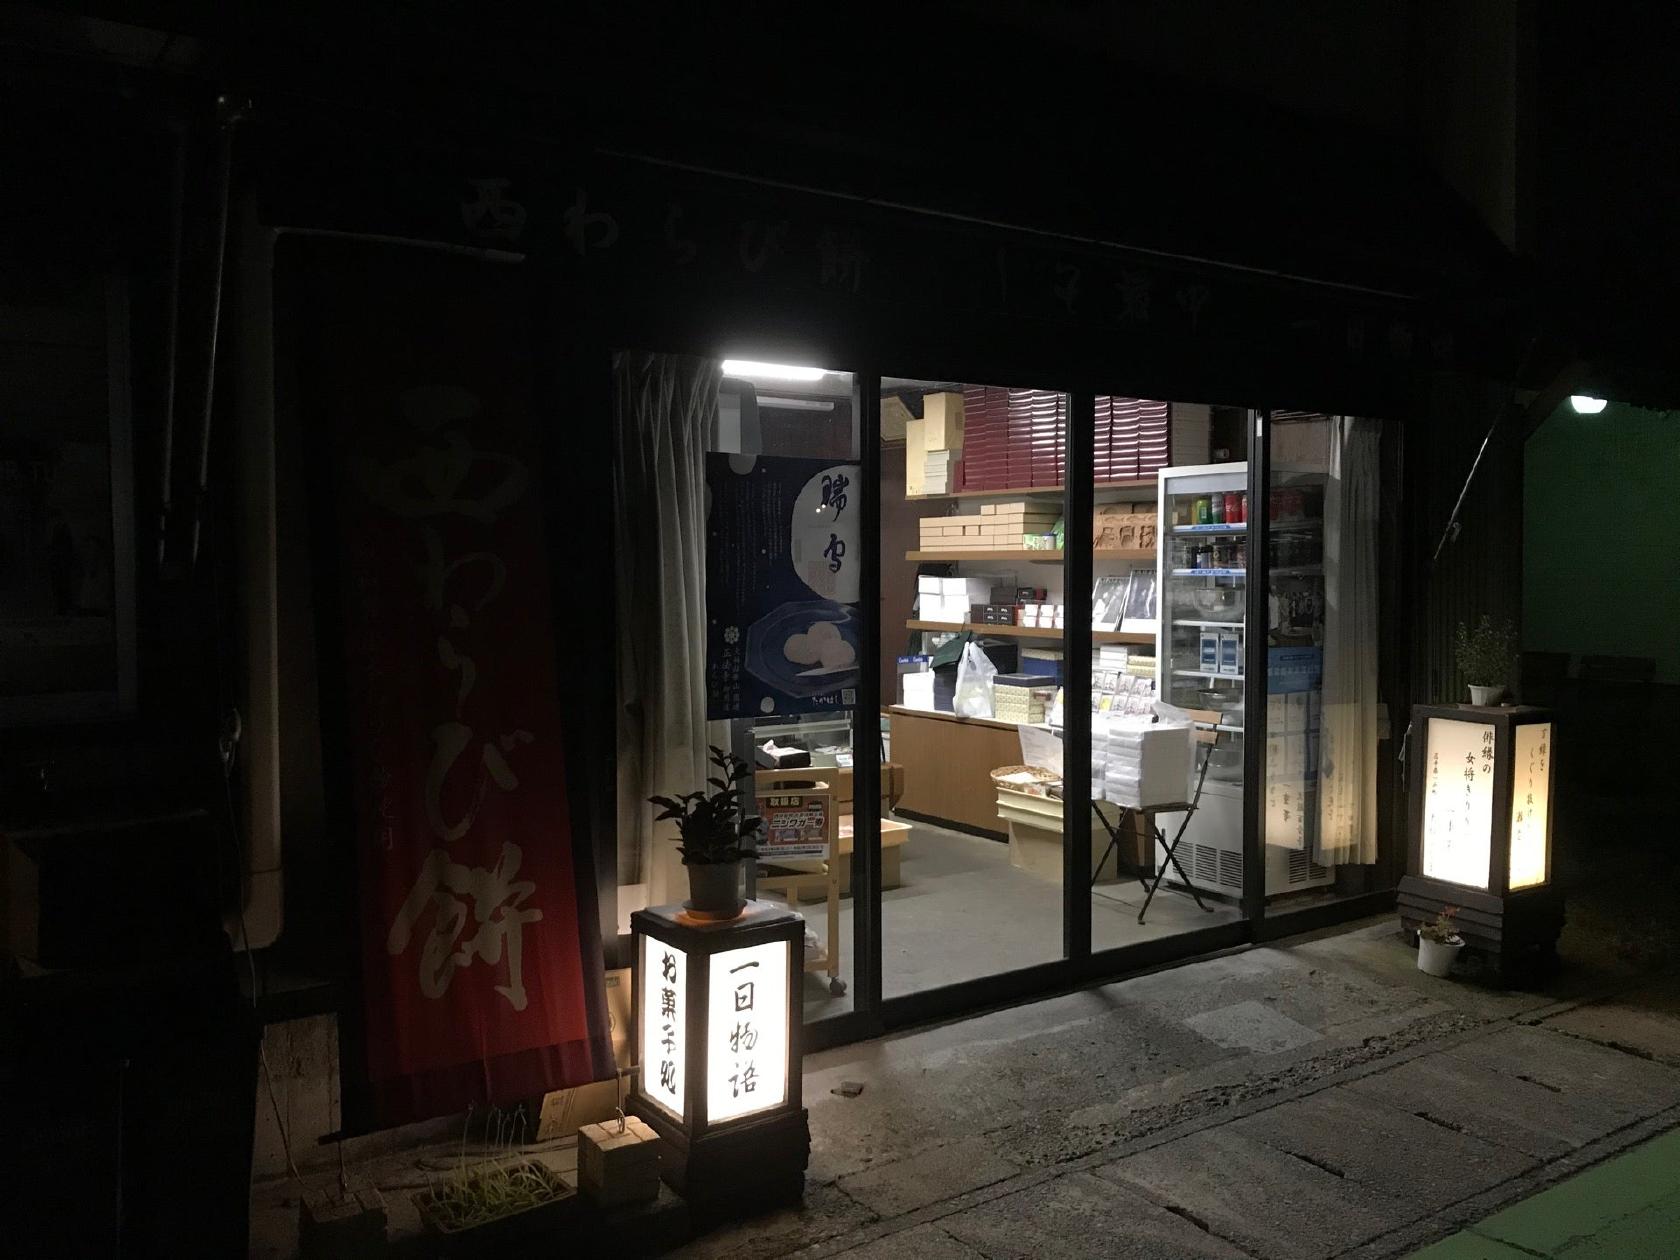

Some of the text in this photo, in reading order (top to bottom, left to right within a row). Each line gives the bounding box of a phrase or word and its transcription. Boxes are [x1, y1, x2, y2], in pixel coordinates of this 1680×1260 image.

[353, 384, 543, 1012] 西わらび餅
[728, 960, 760, 1098] 一日物語
